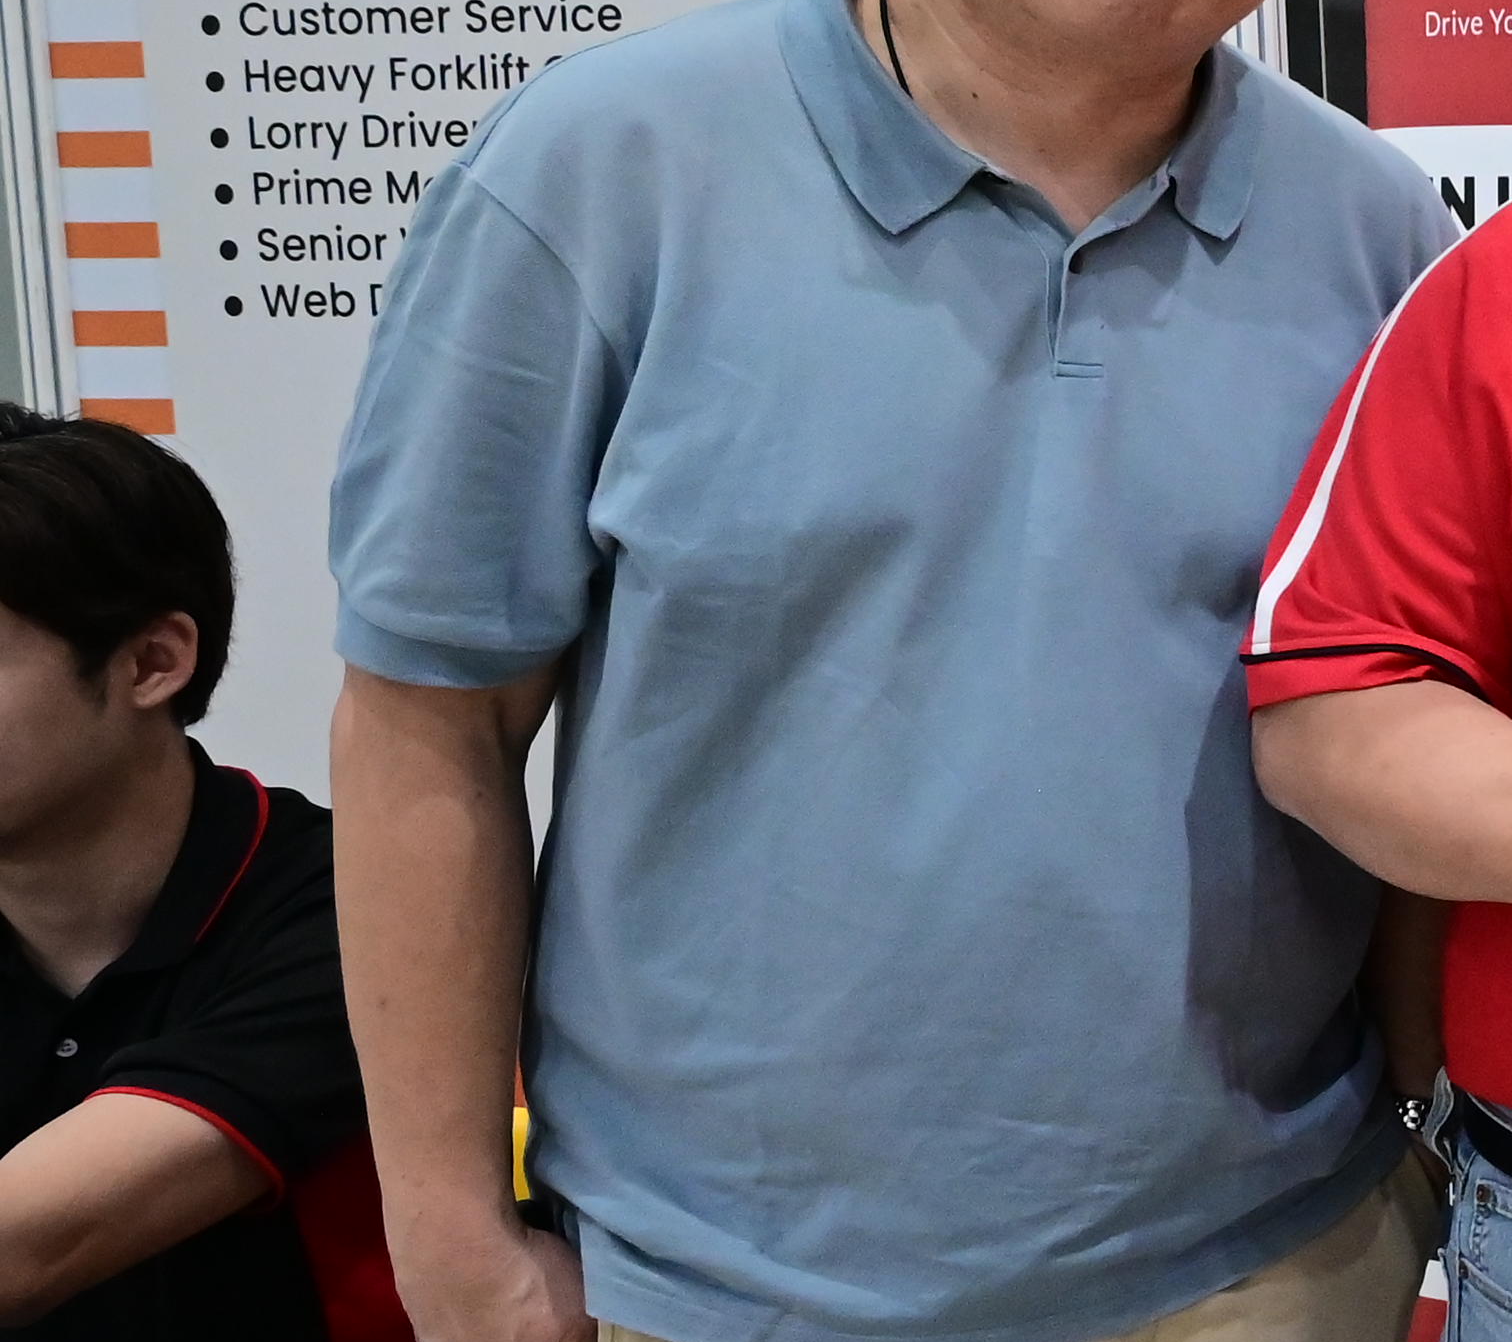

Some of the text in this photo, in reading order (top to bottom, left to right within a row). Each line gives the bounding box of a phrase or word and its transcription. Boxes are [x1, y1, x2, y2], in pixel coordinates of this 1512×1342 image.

[238, 0, 451, 37] Customer
[1424, 6, 1484, 38] Drive
[243, 51, 531, 103] Heavy Forklift
[248, 113, 480, 160] Lorry Drive
[252, 170, 373, 206] Prime
[257, 226, 388, 262] Senior
[260, 283, 357, 318] Web
